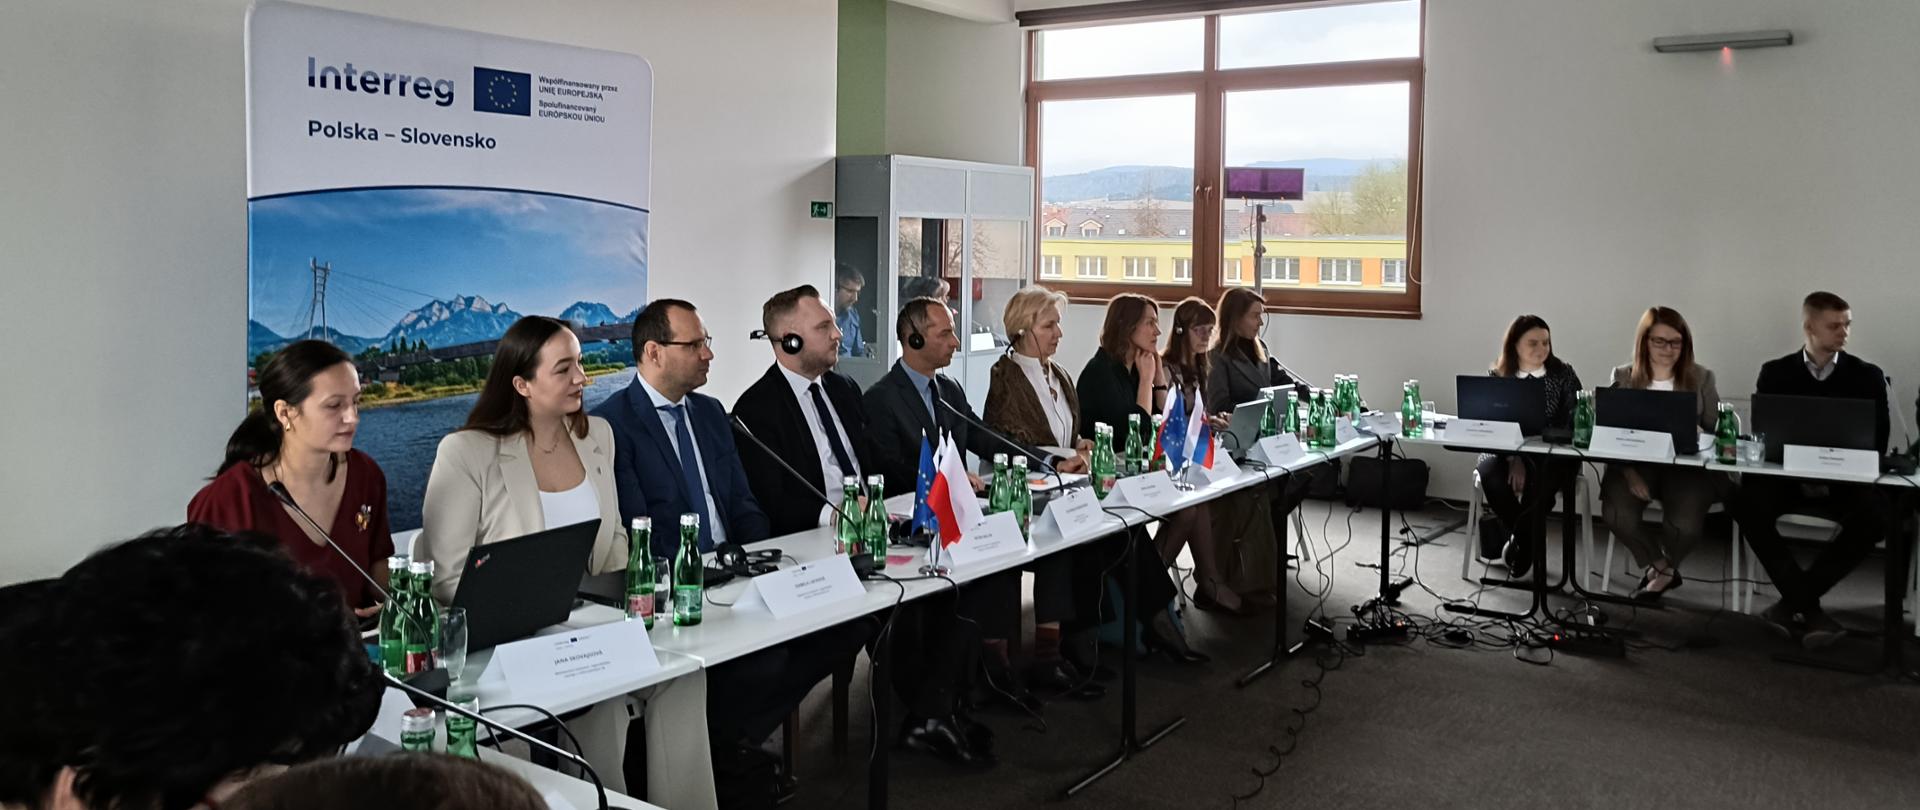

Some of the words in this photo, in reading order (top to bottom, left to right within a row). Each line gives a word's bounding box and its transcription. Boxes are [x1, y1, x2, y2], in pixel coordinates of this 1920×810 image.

[308, 56, 455, 107] Interreg
[538, 75, 600, 91] Współfinansowany
[601, 84, 618, 93] przez
[538, 85, 556, 96] UNIĘ
[557, 88, 604, 102] EUROPEJSKĄ
[308, 120, 378, 141] Polska
[400, 127, 497, 149] Slovensko
